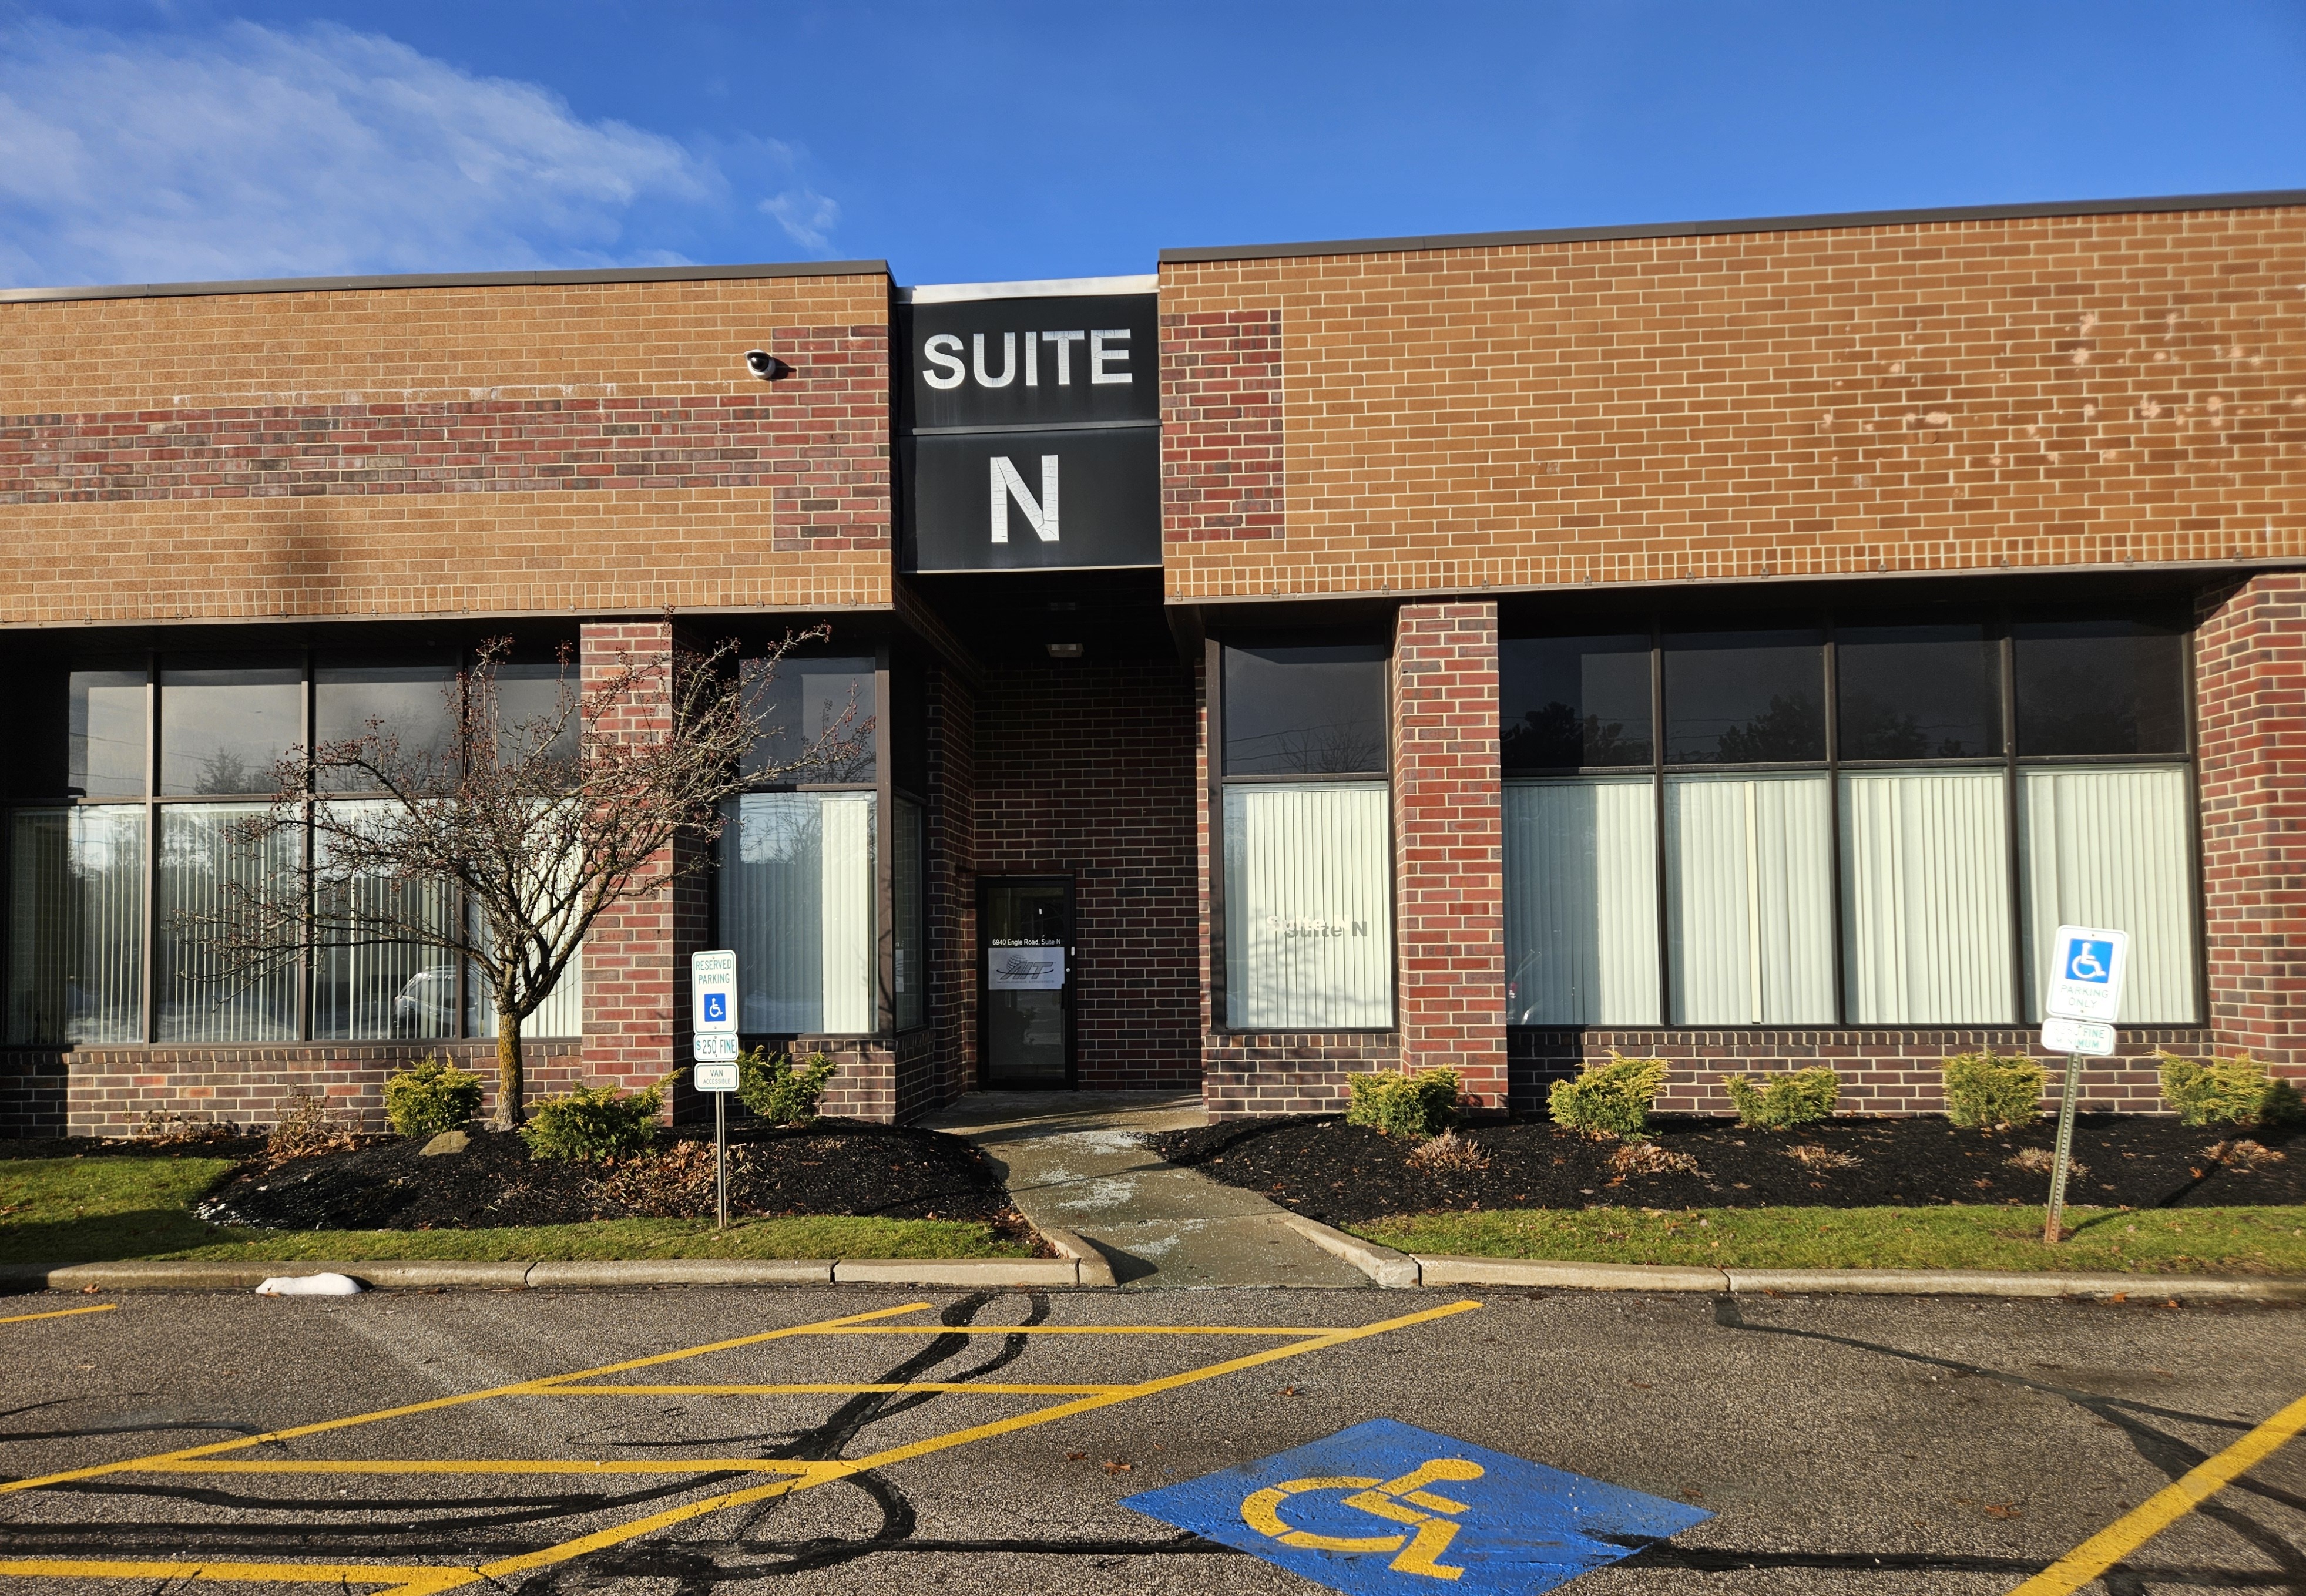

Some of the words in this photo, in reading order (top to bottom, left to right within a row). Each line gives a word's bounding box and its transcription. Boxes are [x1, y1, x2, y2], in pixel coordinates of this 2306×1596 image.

[922, 328, 1133, 389] SUITE
[990, 455, 1059, 543] N
[1266, 915, 1326, 932] Suite
[1334, 914, 1350, 930] N
[696, 959, 732, 971] RESERVED
[1000, 962, 1053, 980] AIT
[699, 973, 730, 985] PARKING
[2061, 985, 2109, 998] PARKING
[2069, 997, 2097, 1009] ONLY
[2083, 1027, 2105, 1039] FINE
[720, 1039, 736, 1054] FINE
[2056, 1036, 2100, 1049] MNIMUM
